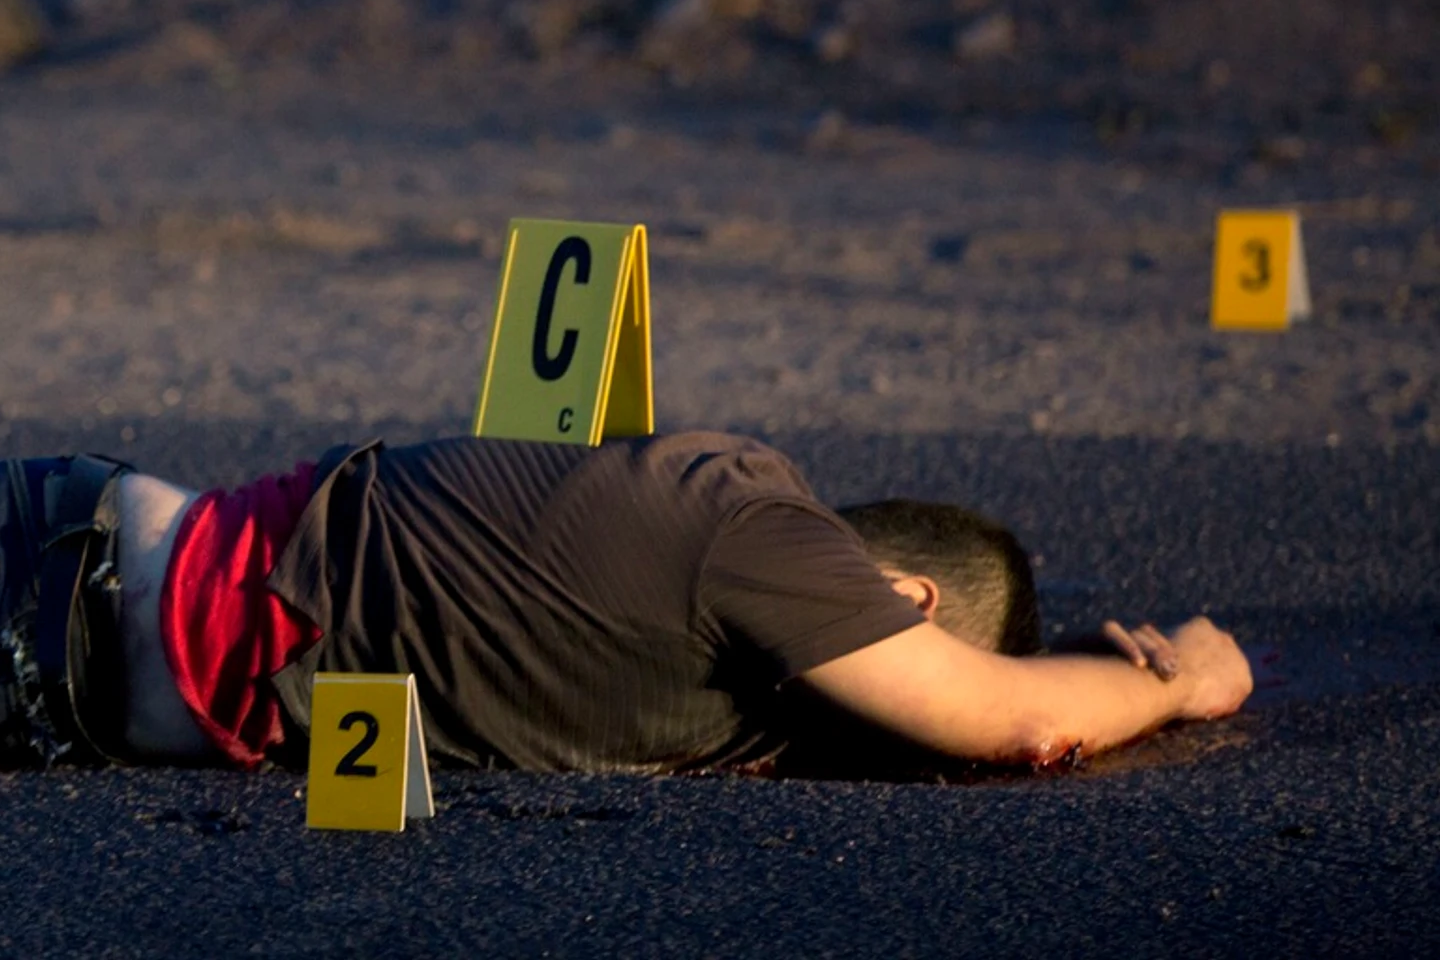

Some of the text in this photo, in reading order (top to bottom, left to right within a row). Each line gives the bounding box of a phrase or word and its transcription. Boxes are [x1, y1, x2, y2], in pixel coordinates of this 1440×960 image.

[1238, 238, 1271, 293] 3
[532, 235, 591, 381] C
[334, 710, 380, 777] 2
